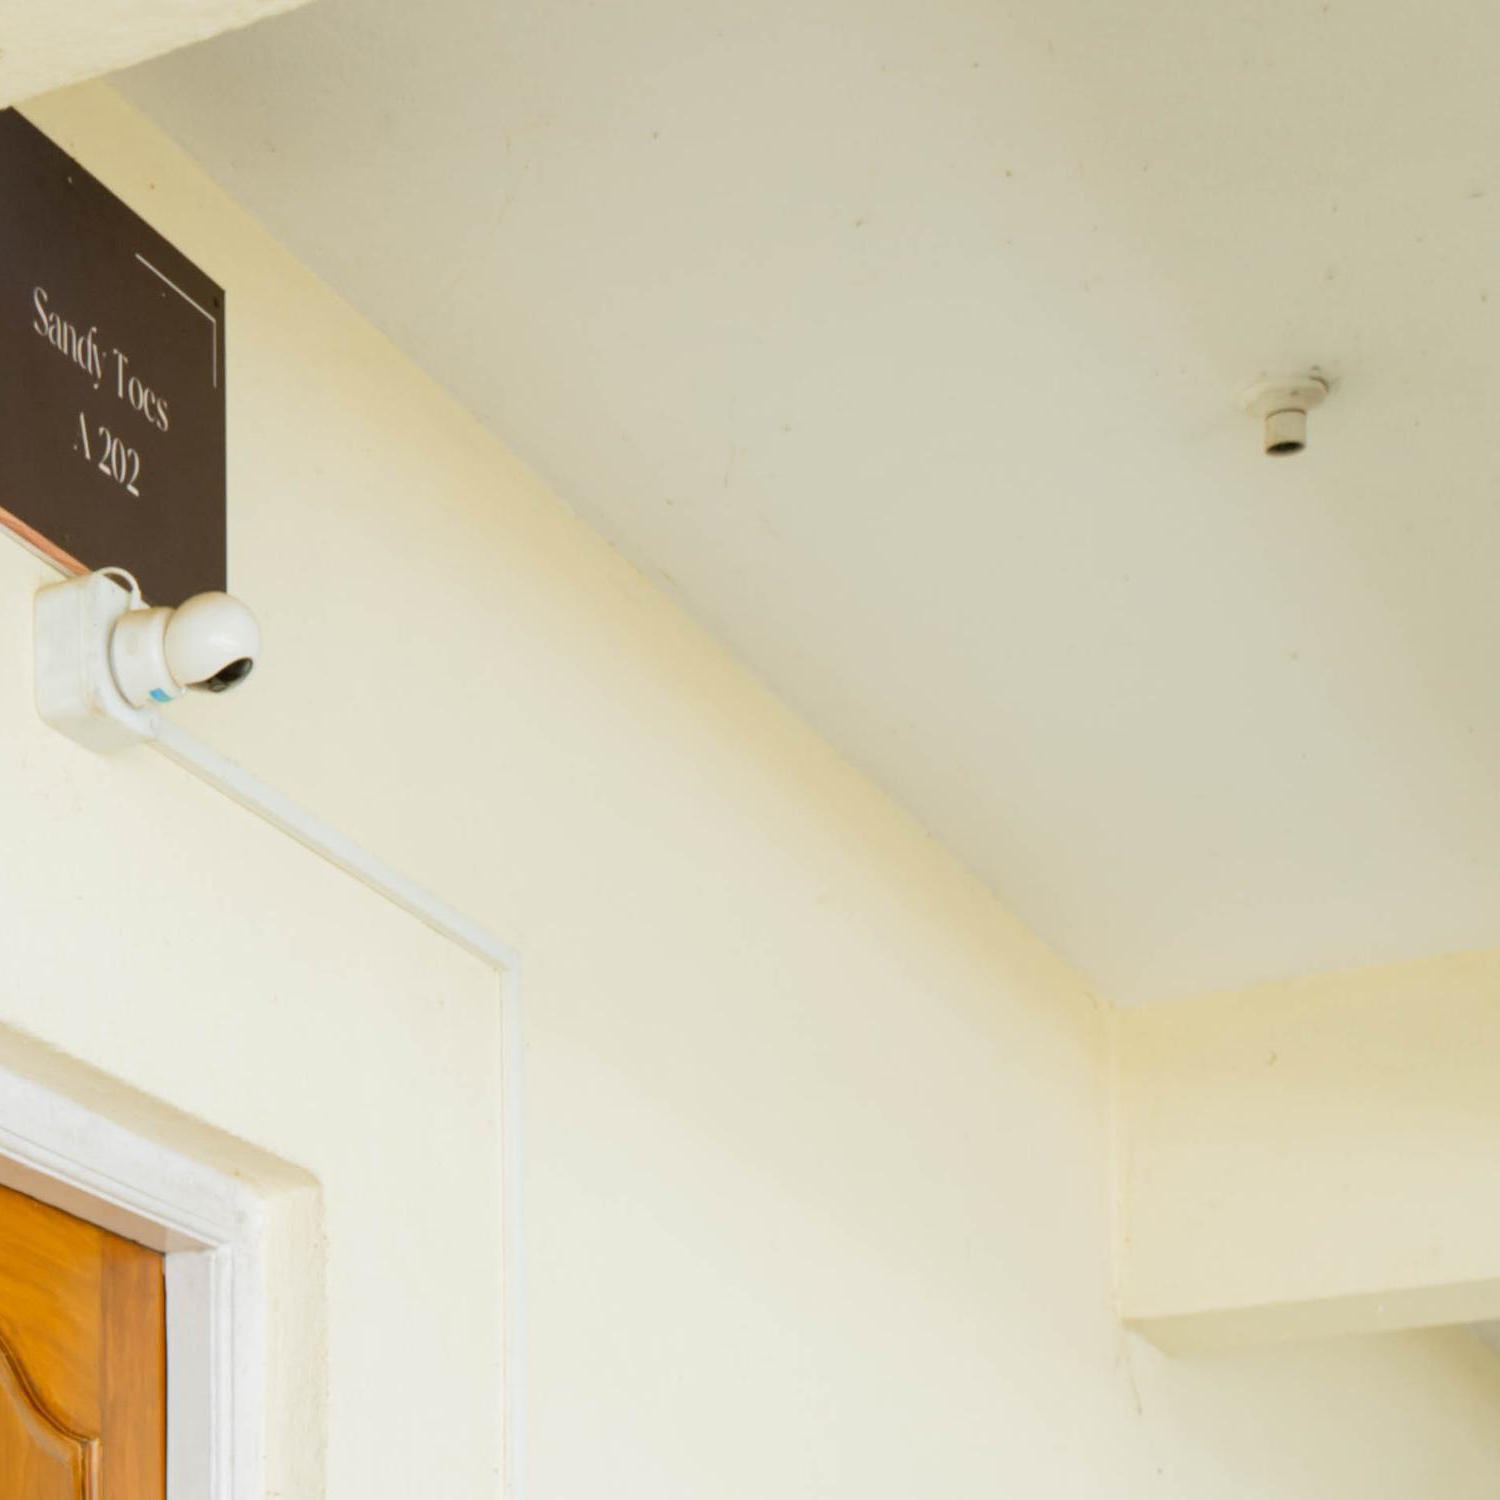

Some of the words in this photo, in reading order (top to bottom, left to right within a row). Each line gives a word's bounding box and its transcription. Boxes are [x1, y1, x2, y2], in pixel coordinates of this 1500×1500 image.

[33, 286, 106, 390] Sandy
[73, 411, 91, 461] A
[98, 427, 140, 497] 202
